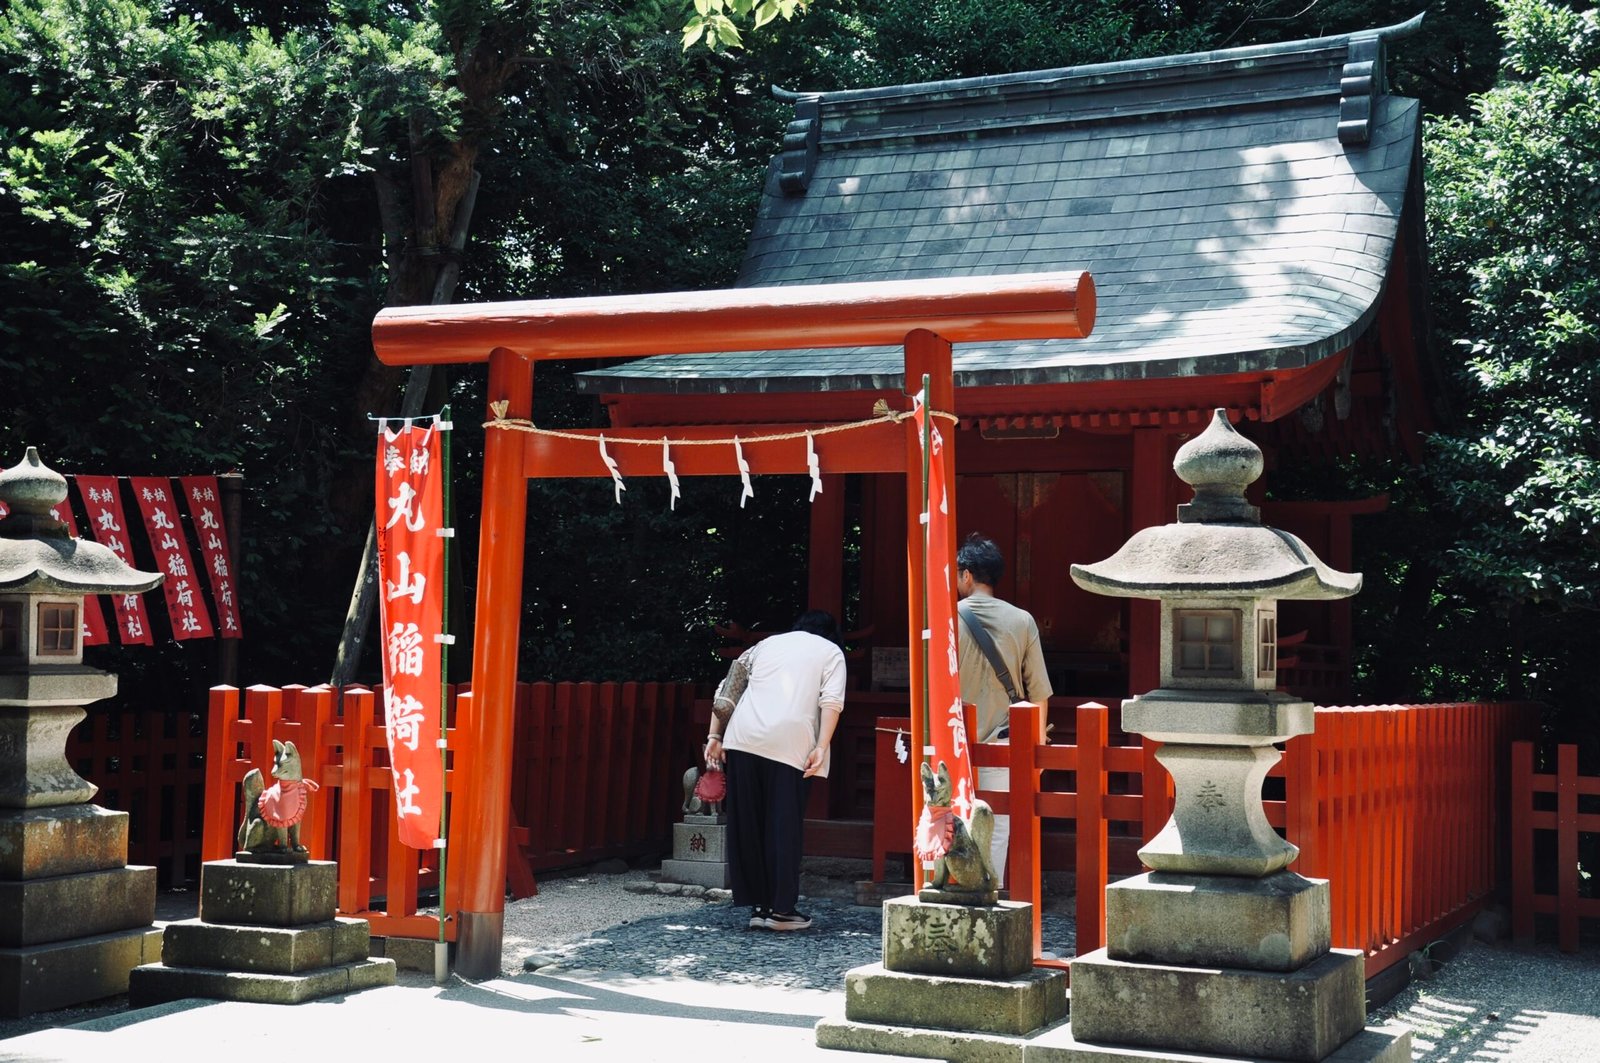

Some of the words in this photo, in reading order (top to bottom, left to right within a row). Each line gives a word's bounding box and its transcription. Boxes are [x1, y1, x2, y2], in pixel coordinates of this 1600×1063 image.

[384, 445, 430, 478] 奉納
[88, 487, 114, 504] 奉納
[142, 487, 167, 503] 奉納
[191, 486, 215, 503] 奉納
[98, 508, 144, 638] 丸山荷社
[152, 507, 202, 632] 丸山稲荷社
[1193, 779, 1226, 813] 奉
[690, 832, 706, 853] 納
